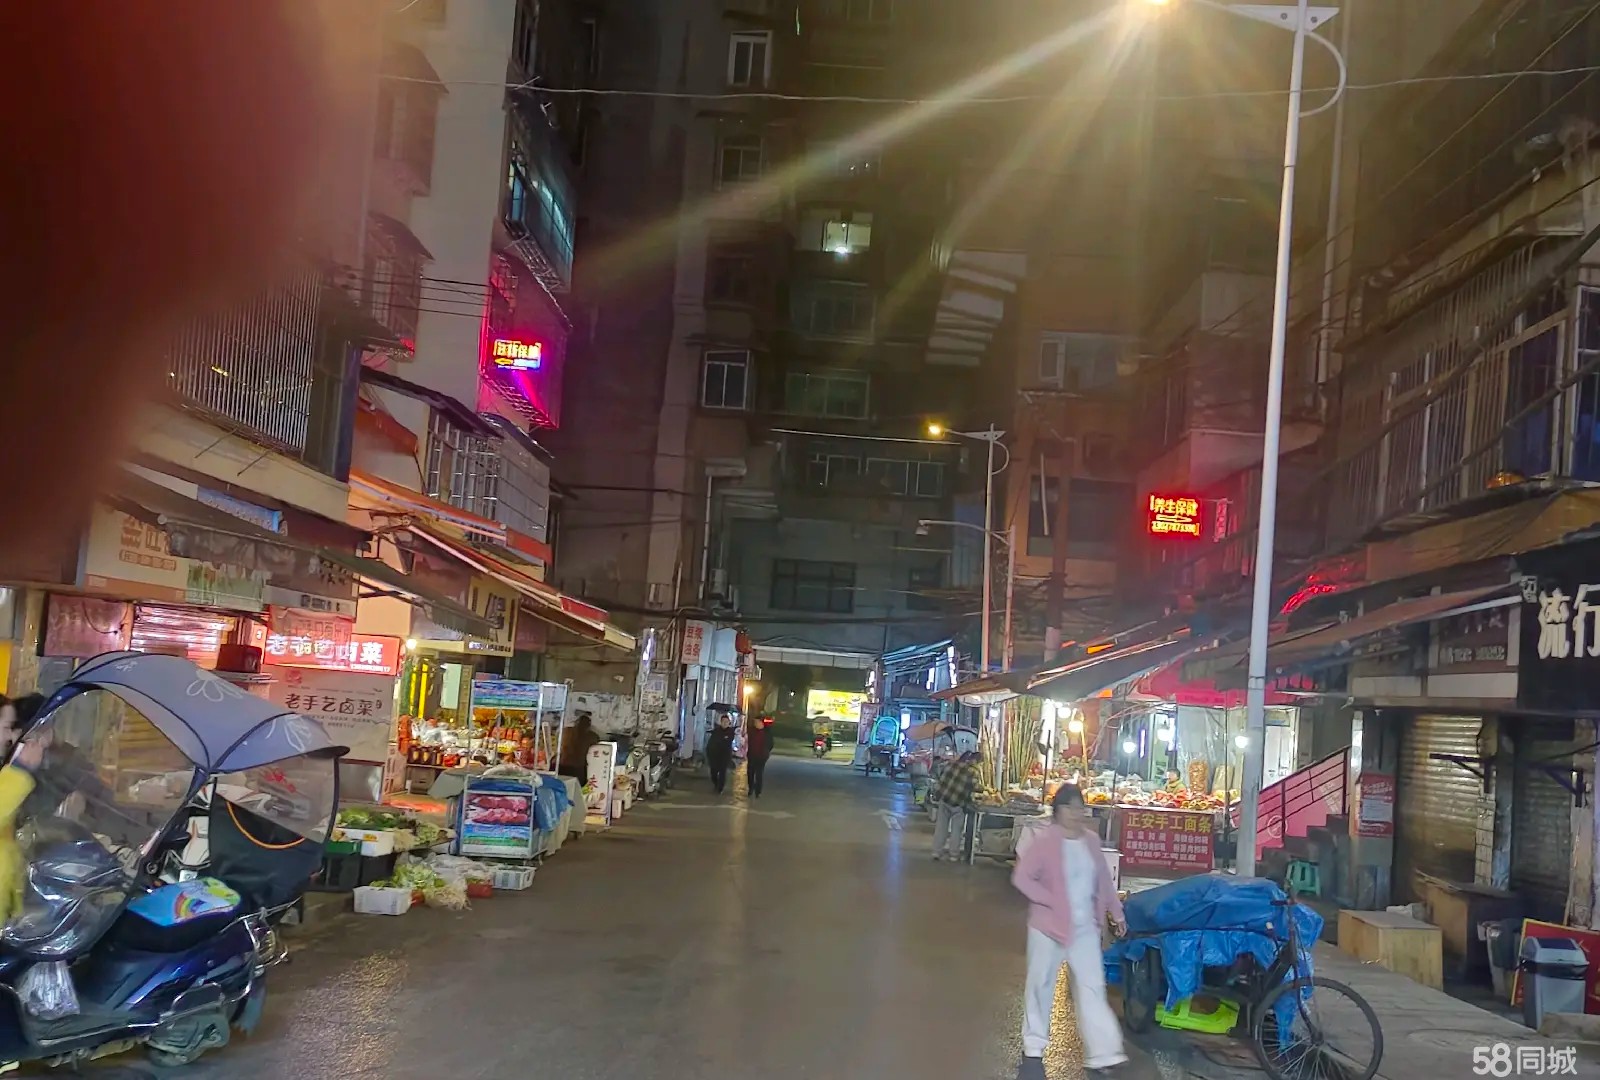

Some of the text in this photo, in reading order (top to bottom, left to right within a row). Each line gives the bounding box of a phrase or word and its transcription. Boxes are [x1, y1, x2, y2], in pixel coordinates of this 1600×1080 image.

[284, 693, 374, 716] 老手艺卤菜
[1126, 812, 1211, 833] 正安手工面条
